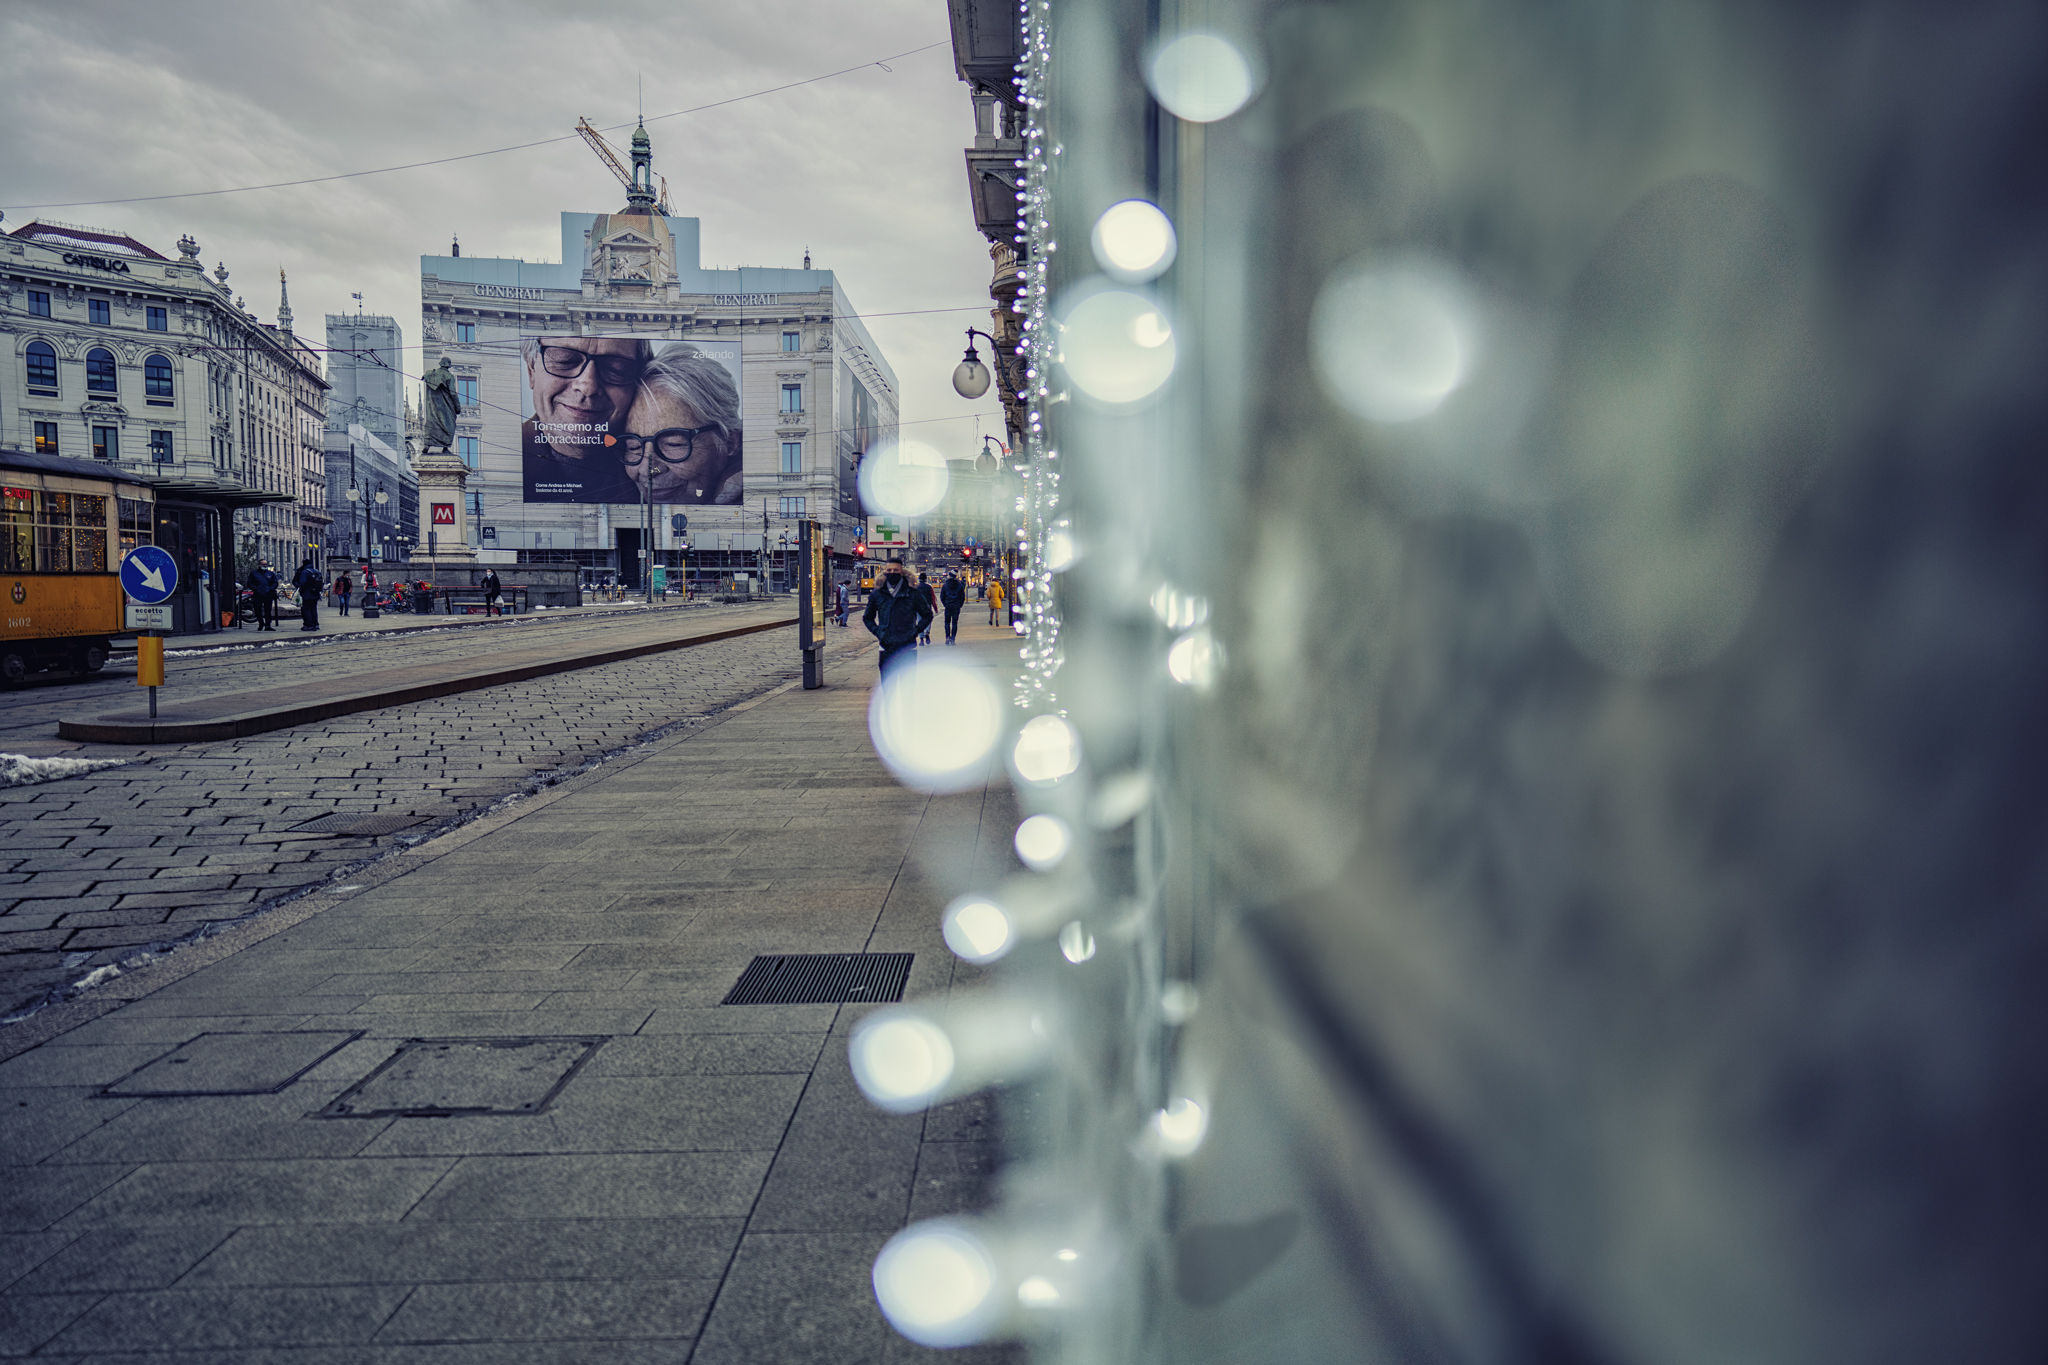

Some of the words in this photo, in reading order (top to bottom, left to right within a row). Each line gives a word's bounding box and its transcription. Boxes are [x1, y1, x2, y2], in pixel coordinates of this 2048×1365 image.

[474, 283, 545, 300] GENERALI
[713, 293, 779, 306] GENERALI
[692, 349, 734, 359] zalando
[594, 421, 609, 432] ad
[534, 433, 604, 445] abbracciarci.
[435, 507, 453, 520] M
[8, 617, 31, 628] 1602
